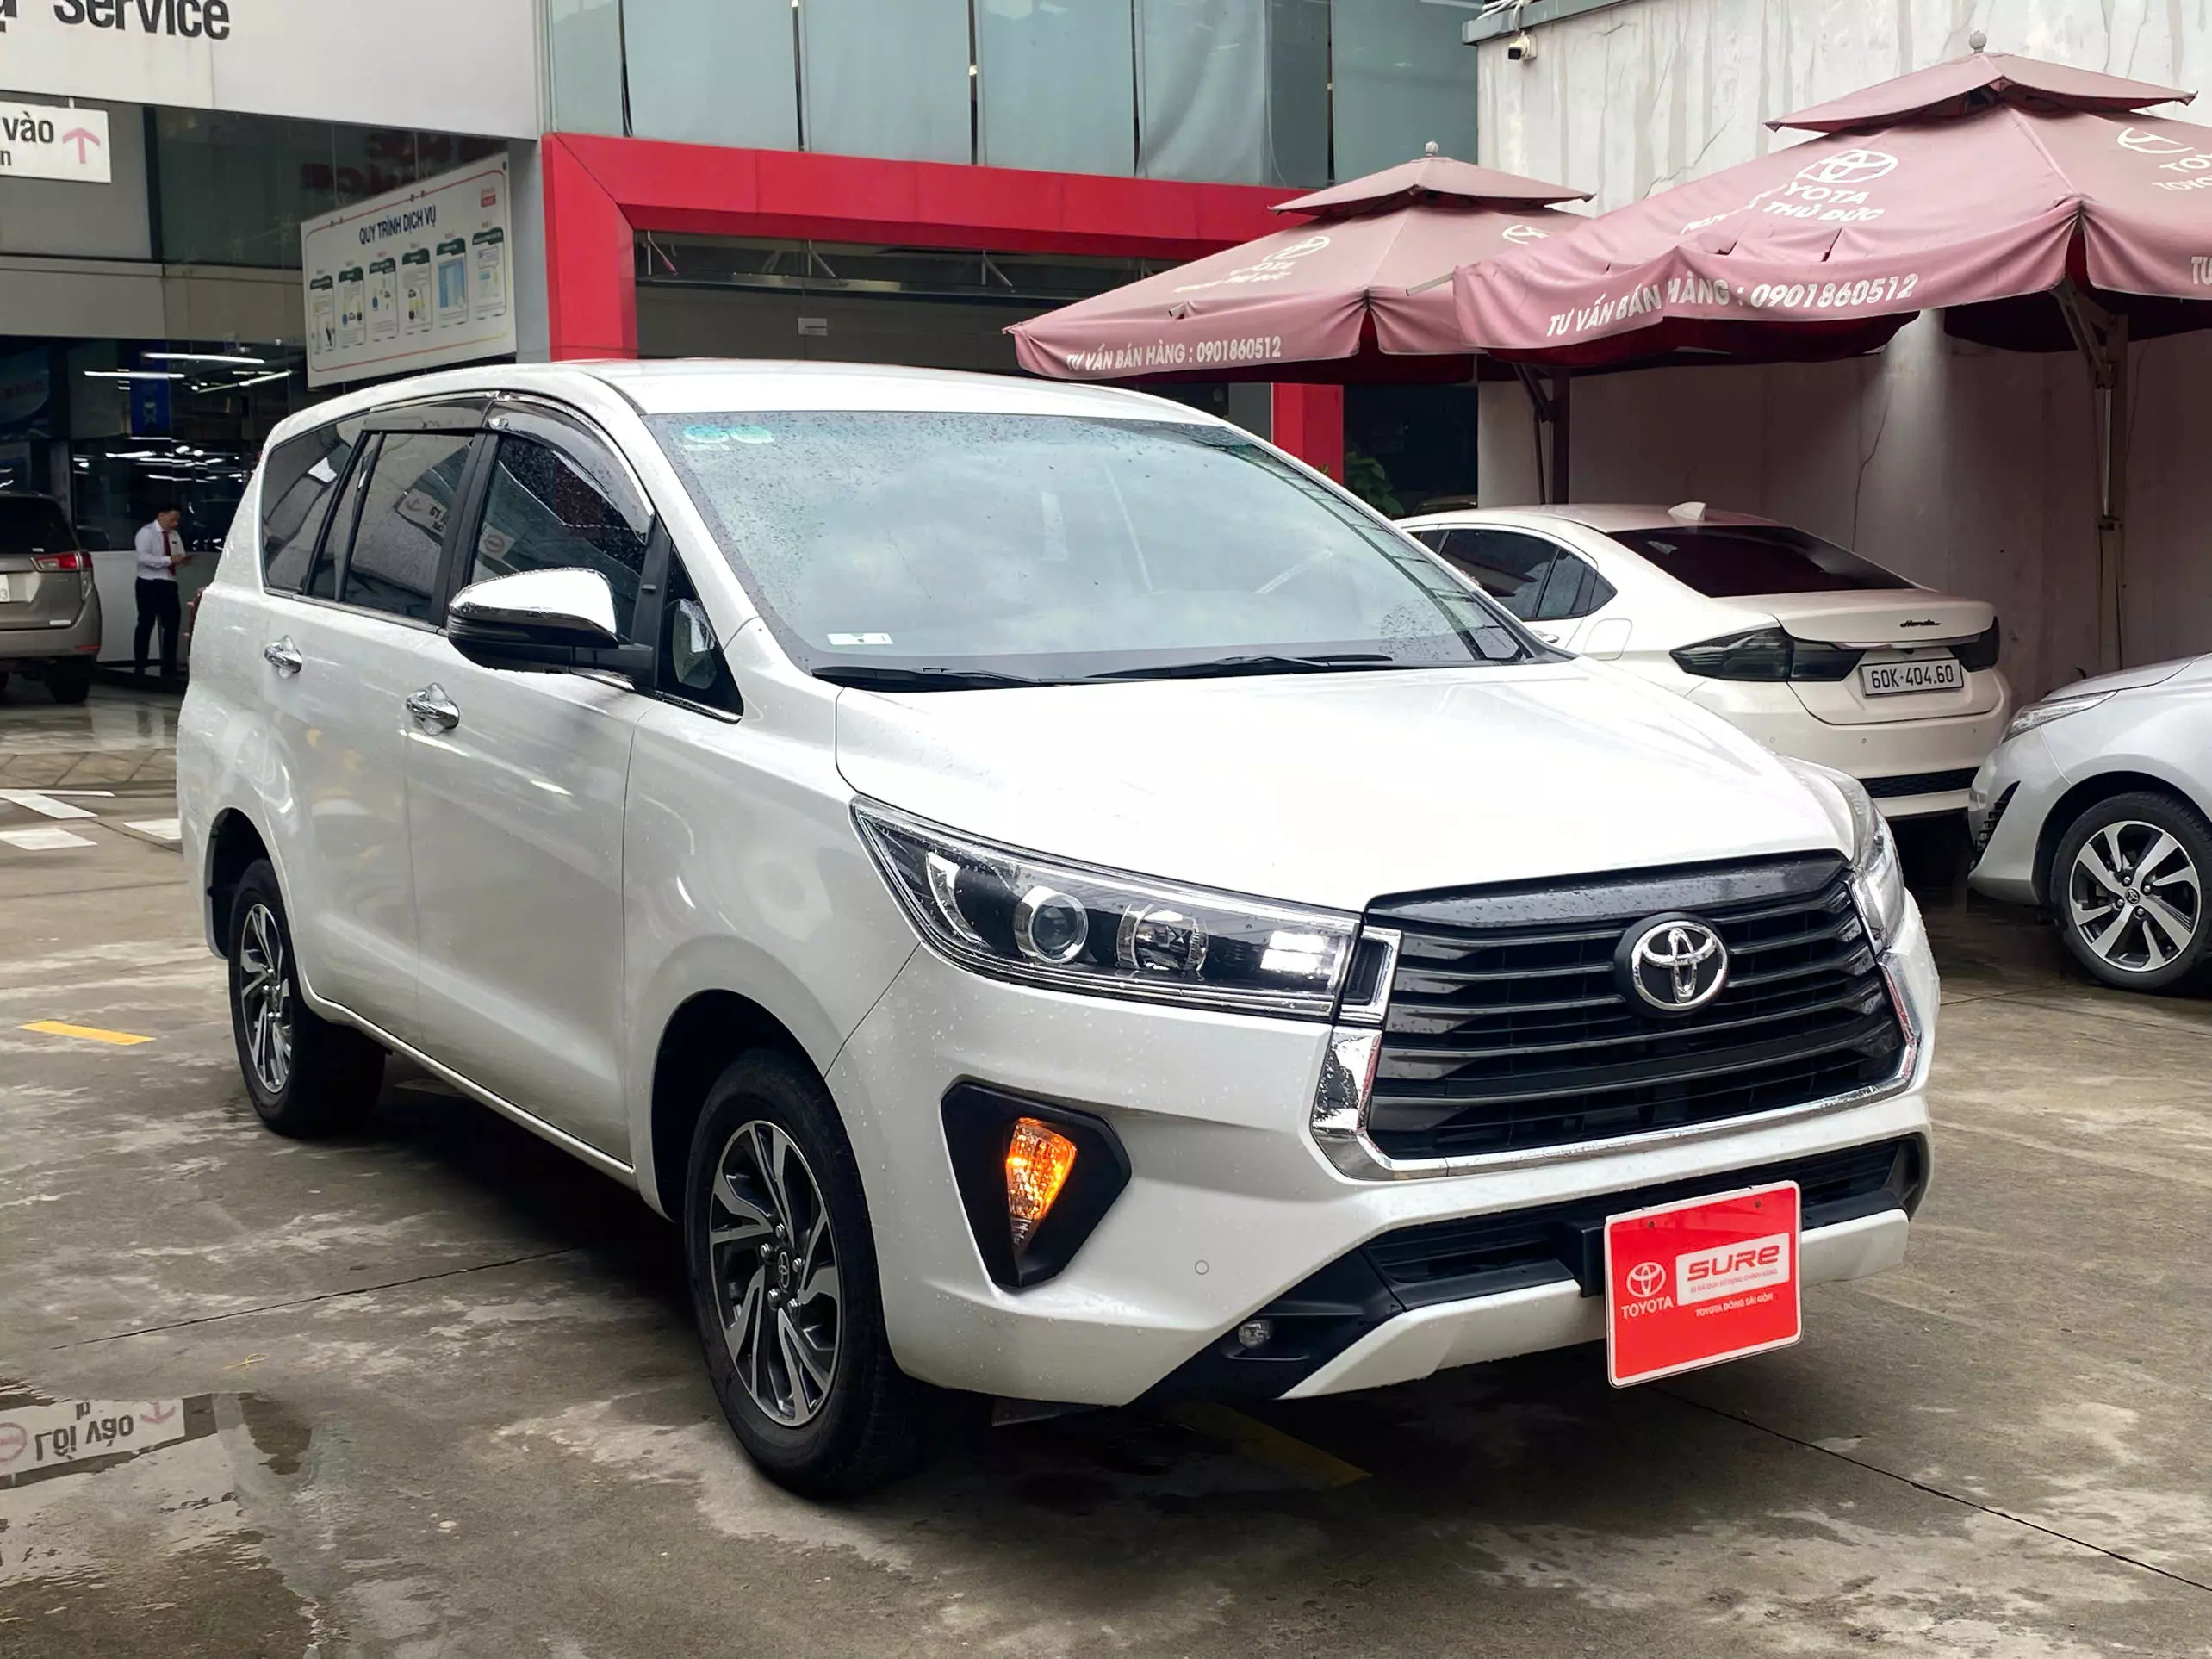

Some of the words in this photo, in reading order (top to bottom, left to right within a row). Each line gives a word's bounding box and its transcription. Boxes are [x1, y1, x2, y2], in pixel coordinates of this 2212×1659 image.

[3, 111, 54, 145] vào
[359, 224, 376, 245] QUY
[377, 214, 402, 239] TRÌNH
[403, 209, 423, 234] DỊCH
[424, 204, 436, 227] VỤ
[1546, 309, 1575, 336] TƯ
[1575, 293, 1612, 332] VẤN
[1616, 283, 1662, 320] BÁN
[1667, 270, 1730, 307] HÀNG
[1750, 273, 1919, 309] 0901860512
[1085, 344, 1113, 370] VẤN
[1115, 342, 1142, 369] BÁN
[1146, 339, 1185, 365] HÀNG
[1196, 336, 1282, 363] 0901860512
[1899, 618, 1941, 628] Honda
[1621, 1296, 1675, 1319] TOYOTA
[1695, 1303, 1723, 1316] TOYOTA
[1723, 1299, 1745, 1311] ĐÔNG
